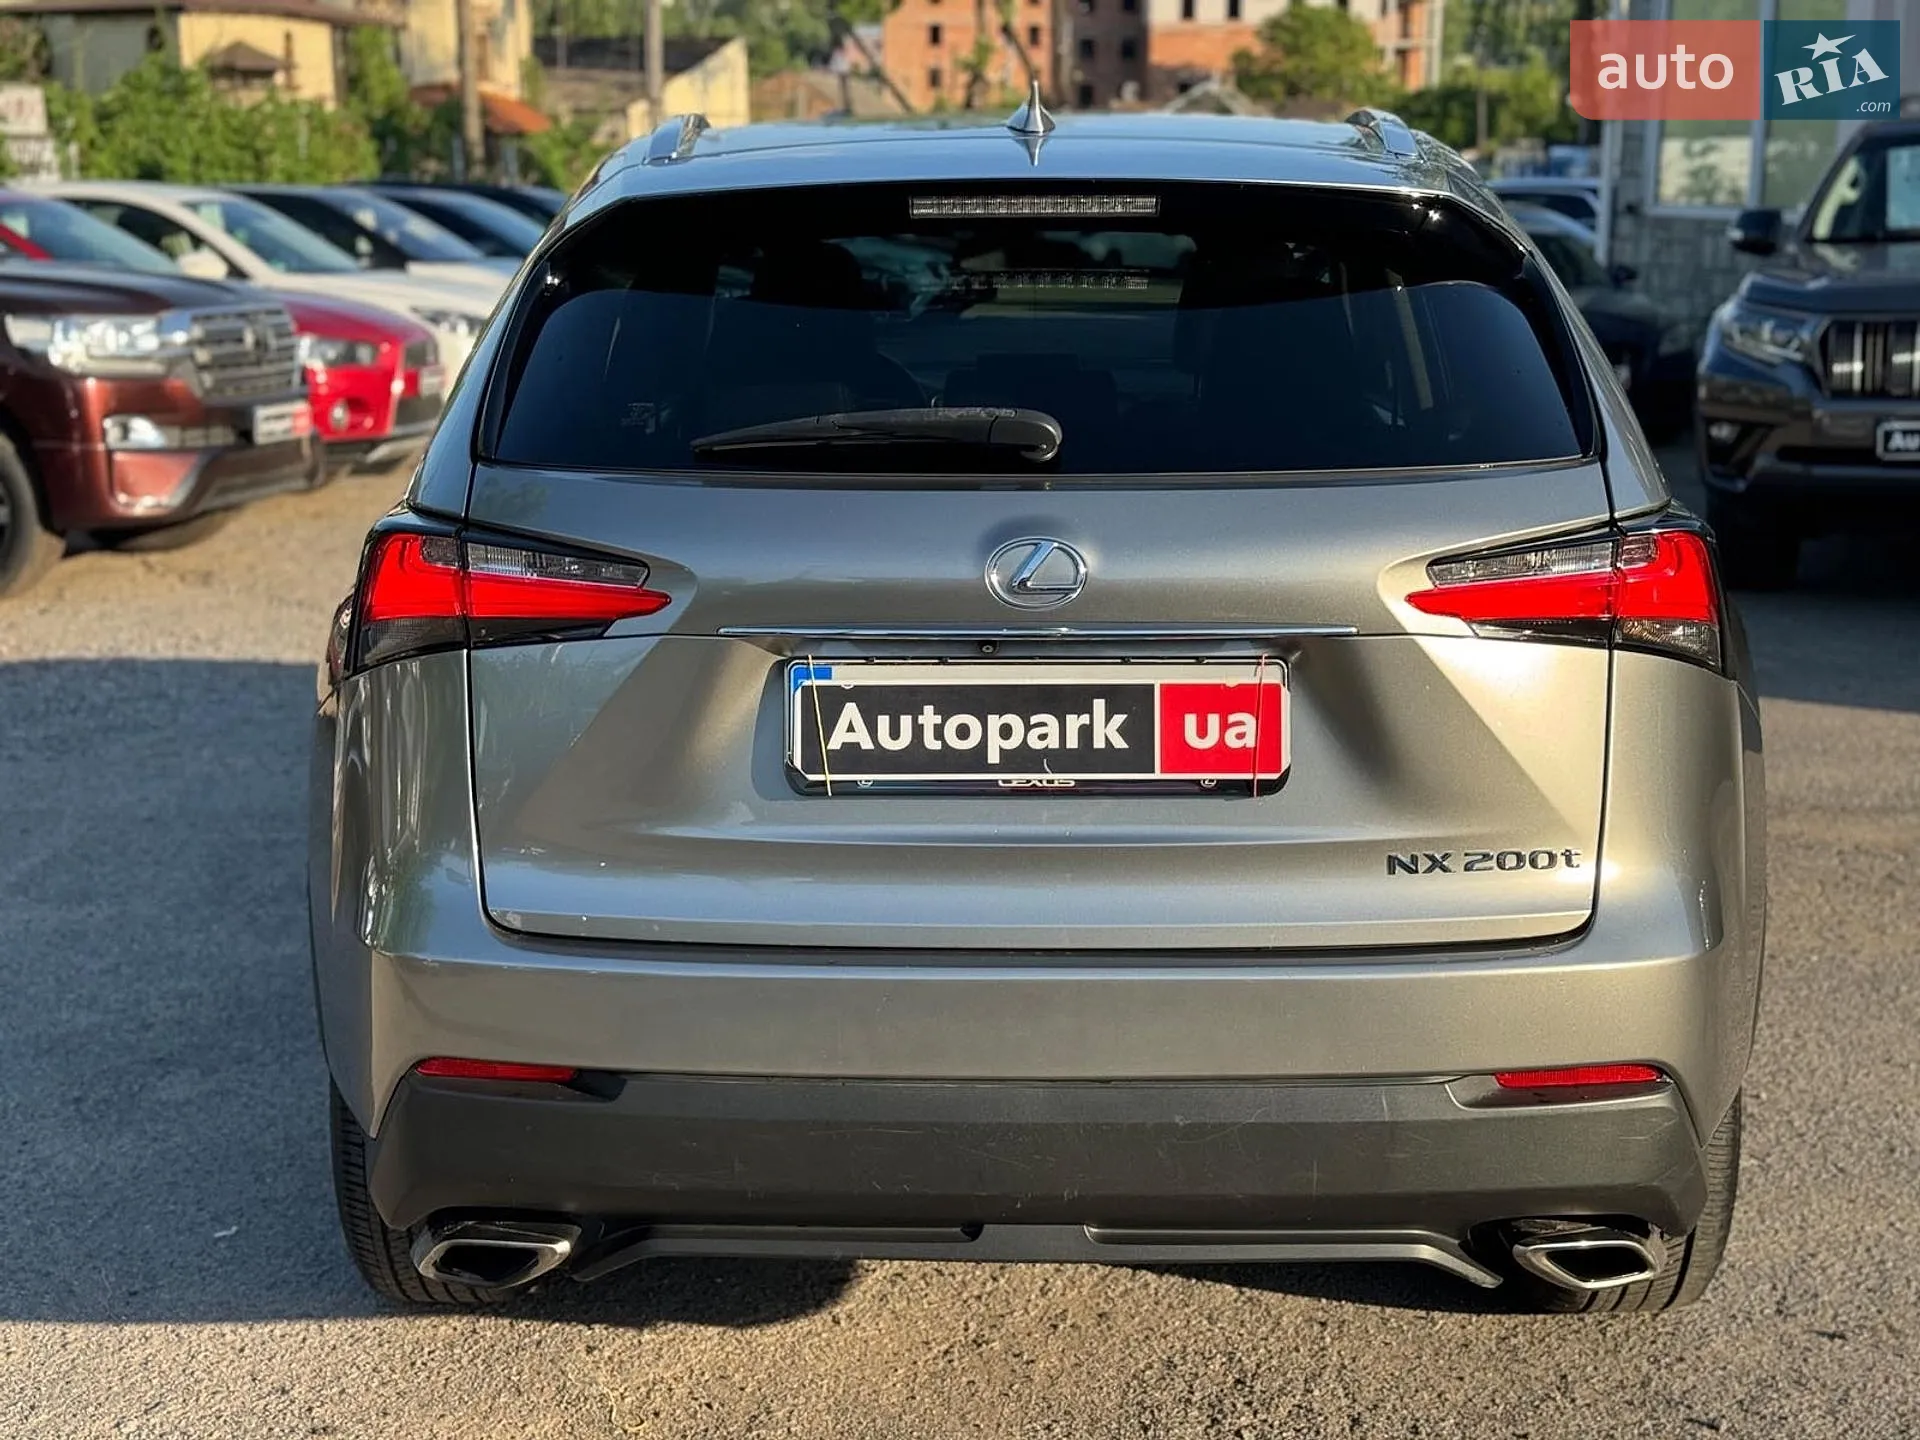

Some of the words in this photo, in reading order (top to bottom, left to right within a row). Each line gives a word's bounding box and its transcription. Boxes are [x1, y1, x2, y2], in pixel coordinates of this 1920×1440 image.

[826, 698, 1129, 764] Autopark
[1182, 712, 1258, 750] ua
[1386, 851, 1456, 875] NX
[1463, 848, 1583, 873] 200t
